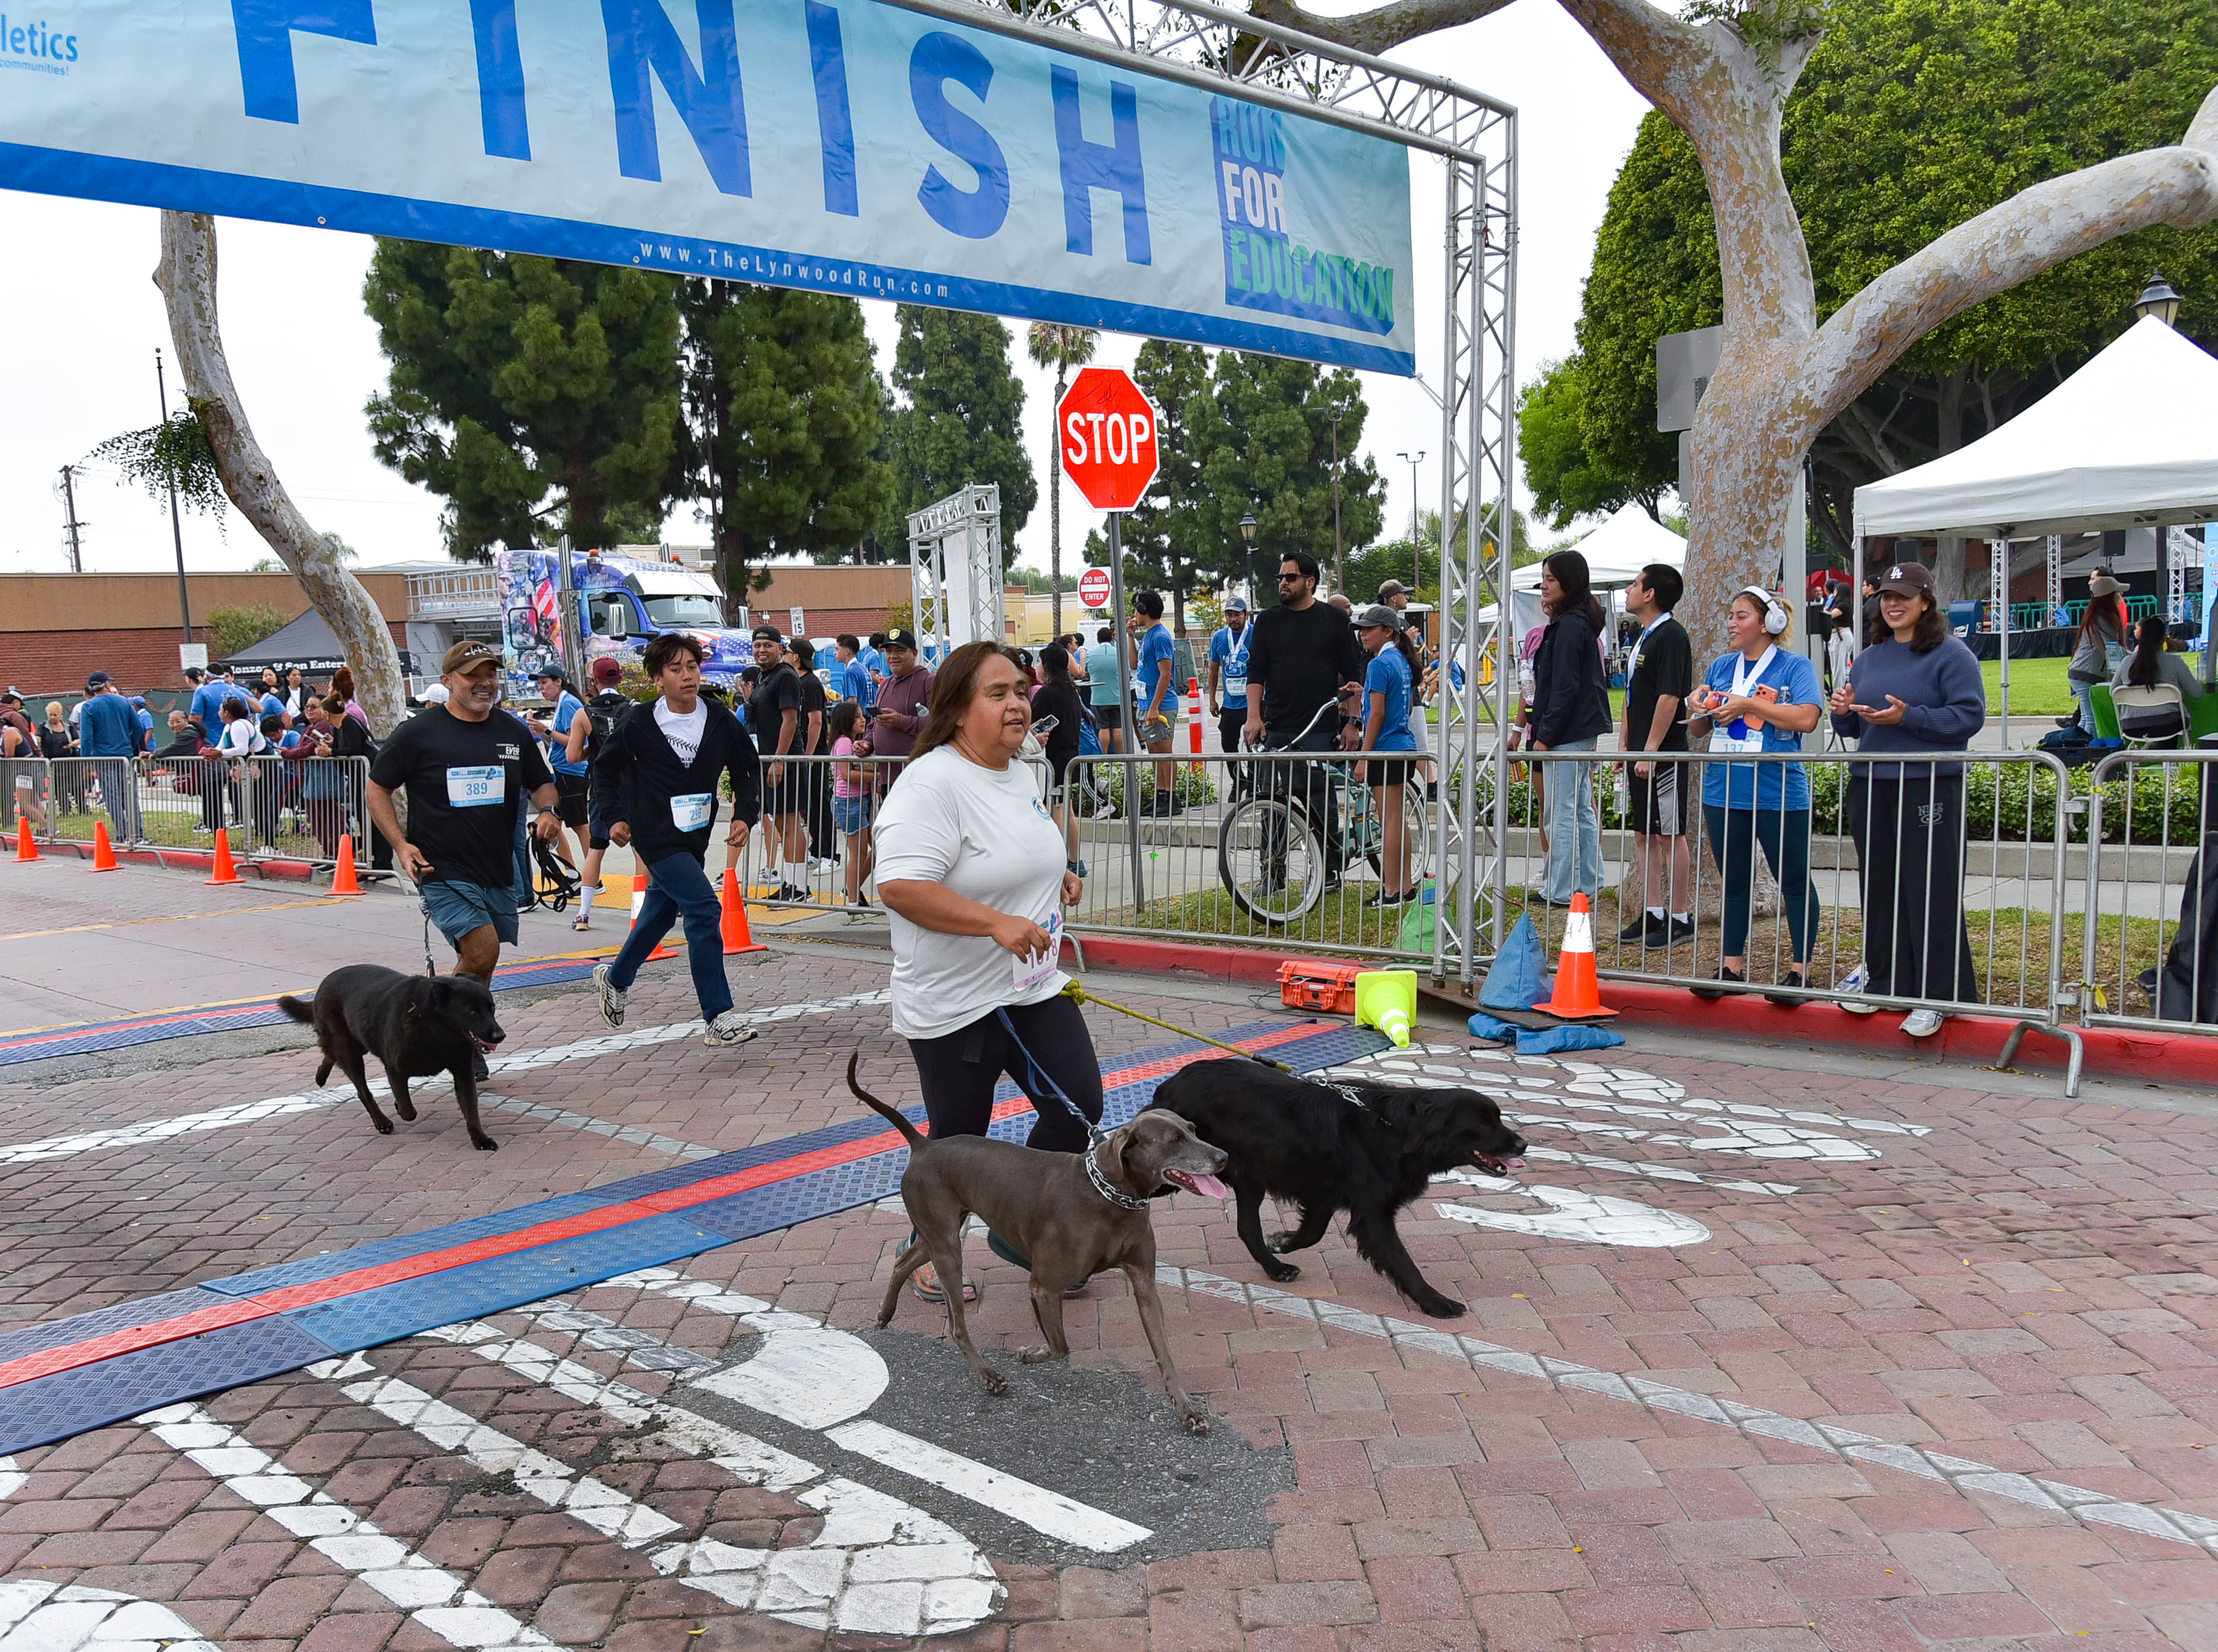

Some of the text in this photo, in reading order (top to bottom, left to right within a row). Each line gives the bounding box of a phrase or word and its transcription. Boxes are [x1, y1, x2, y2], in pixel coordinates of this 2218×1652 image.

[1, 13, 78, 62] letics
[1214, 94, 1286, 172] RUN
[1221, 160, 1289, 235] FOR
[640, 242, 949, 299] www.TheLynwoodRun.com
[1230, 227, 1395, 322] EDUCATION
[1066, 411, 1151, 465] STOP
[1083, 575, 1106, 584] DO NOT
[1085, 592, 1105, 601] ENTER
[794, 623, 803, 634] 15
[273, 662, 283, 671] &
[505, 746, 520, 756] EVER
[1723, 741, 1745, 753] 137
[465, 782, 488, 796] 389
